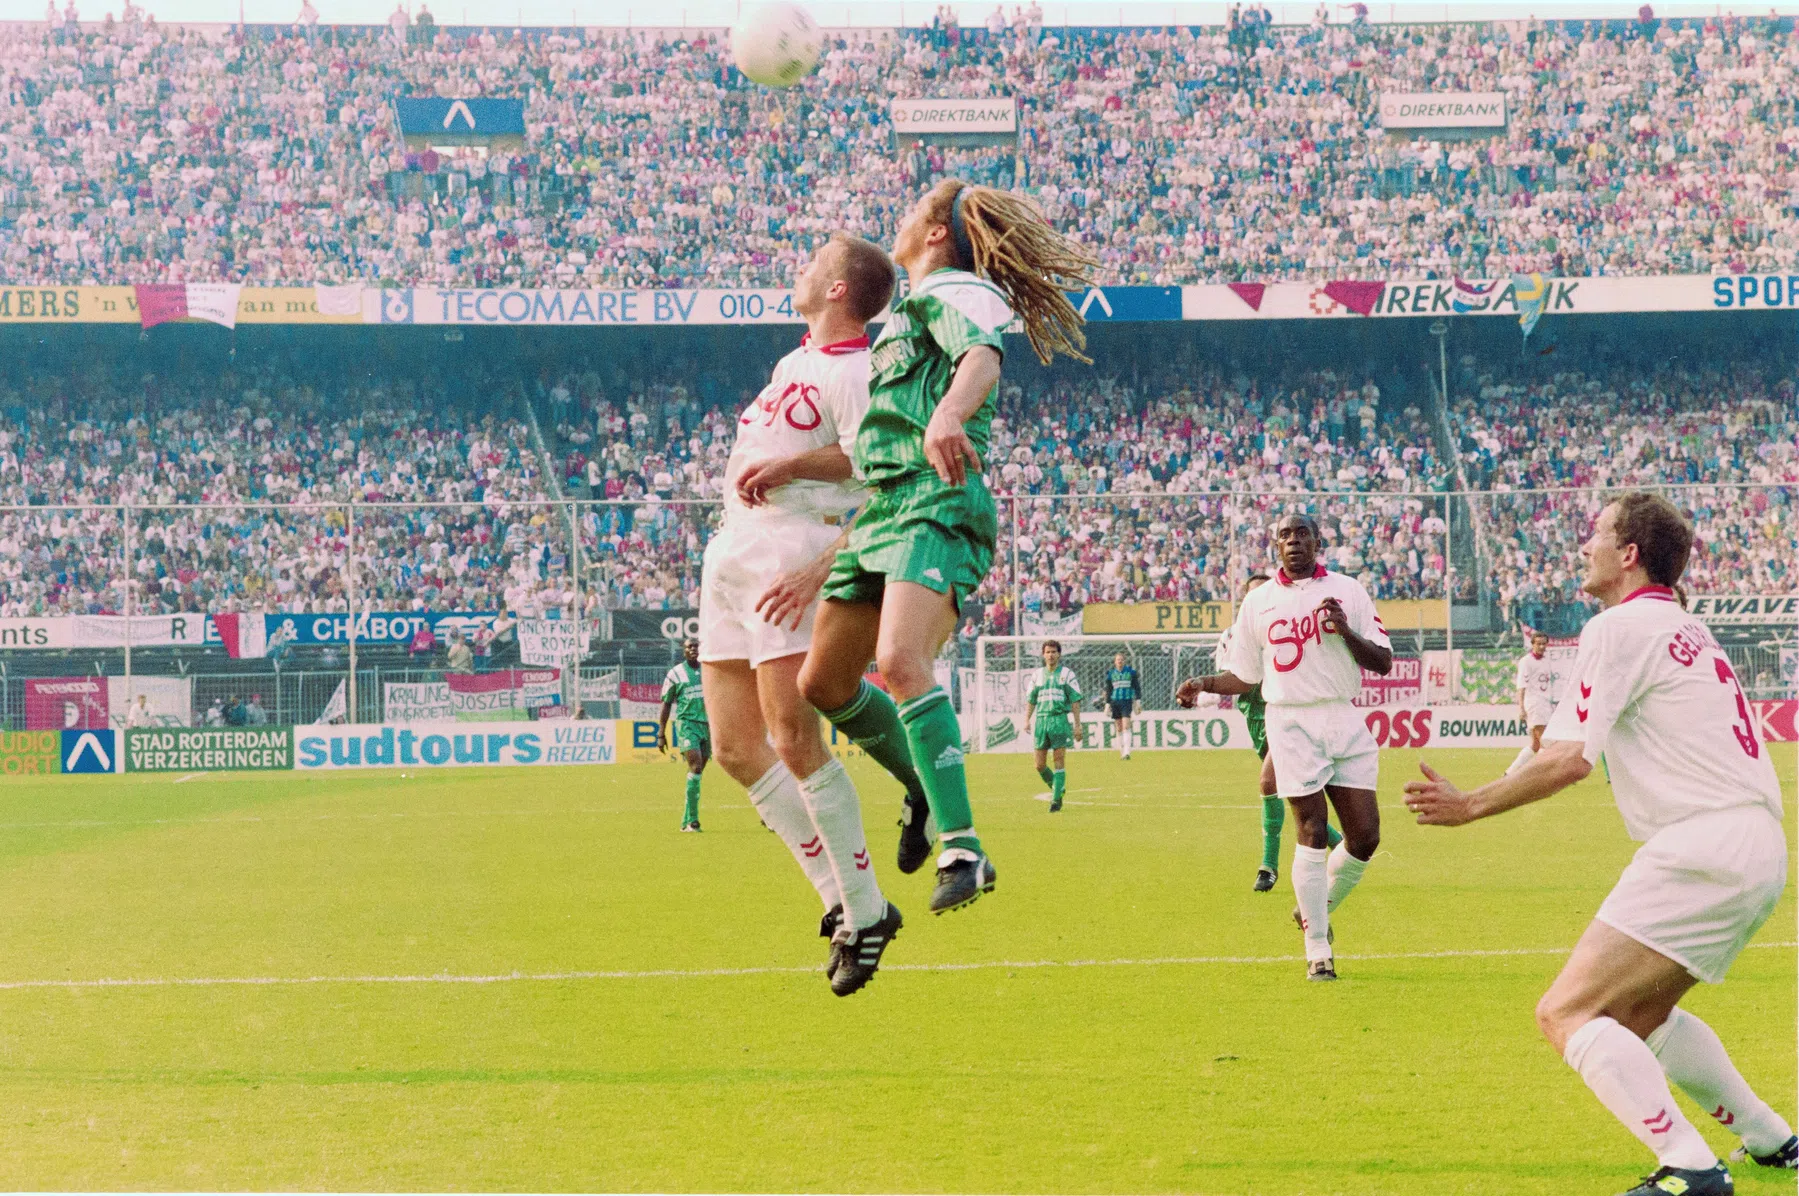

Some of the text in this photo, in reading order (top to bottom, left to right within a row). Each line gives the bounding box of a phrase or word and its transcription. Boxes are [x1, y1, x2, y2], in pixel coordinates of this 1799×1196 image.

[912, 109, 1011, 122] DIREKTBANK
[1400, 104, 1500, 117] DIREKTBANK
[238, 300, 275, 312] an
[437, 291, 800, 322] TECOMARE BV 010-4
[1346, 282, 1579, 315] IREKAK
[1685, 598, 1798, 615] EWAVE
[1156, 605, 1222, 629] PIET
[2, 625, 48, 645] nts
[283, 618, 299, 641] &
[312, 616, 426, 640] CHABOT
[130, 731, 287, 751] STAD ROTTERDAM
[555, 727, 605, 744] VLIEG
[1071, 718, 1230, 748] EPHISTO
[299, 727, 542, 768] sudtours
[546, 745, 612, 762] REIZEN
[131, 750, 287, 769] VERZEKERINGEN
